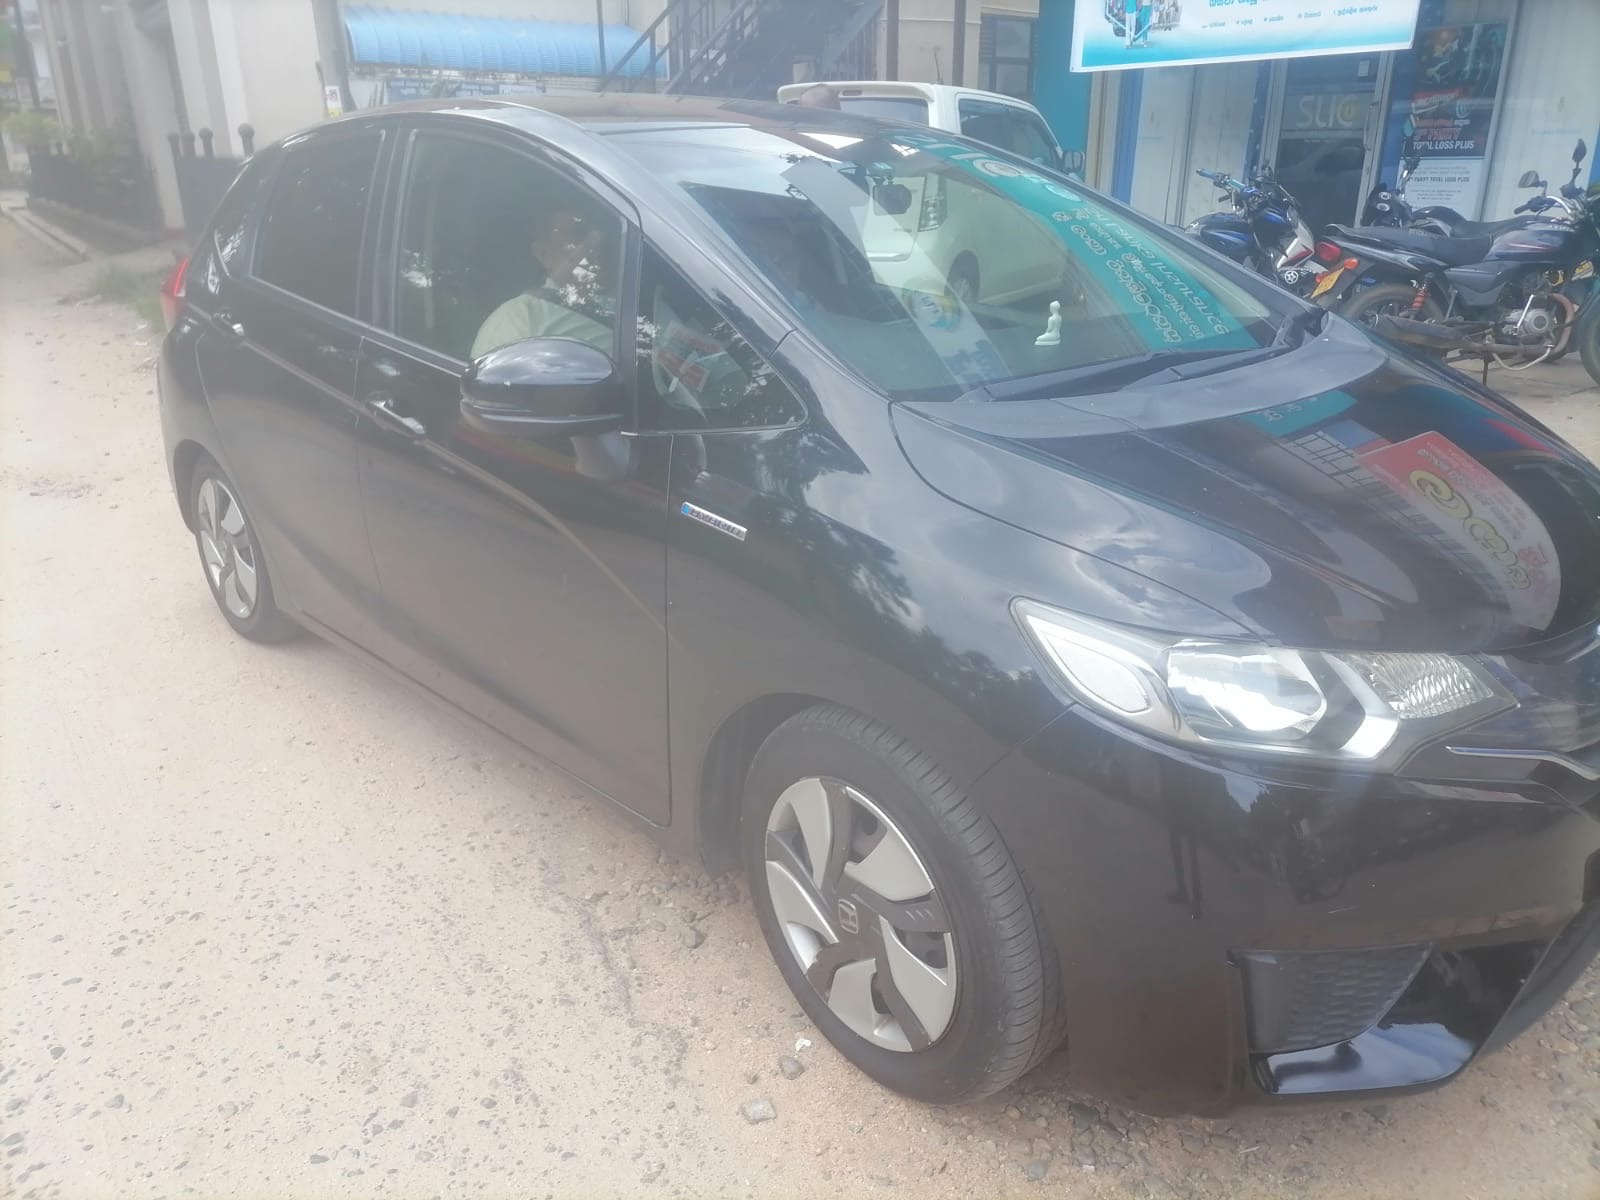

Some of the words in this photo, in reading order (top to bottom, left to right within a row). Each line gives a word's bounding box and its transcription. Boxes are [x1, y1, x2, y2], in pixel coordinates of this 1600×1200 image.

[1296, 95, 1355, 127] SLIC
[1435, 140, 1455, 150] LOSS
[1455, 140, 1475, 150] PLUS
